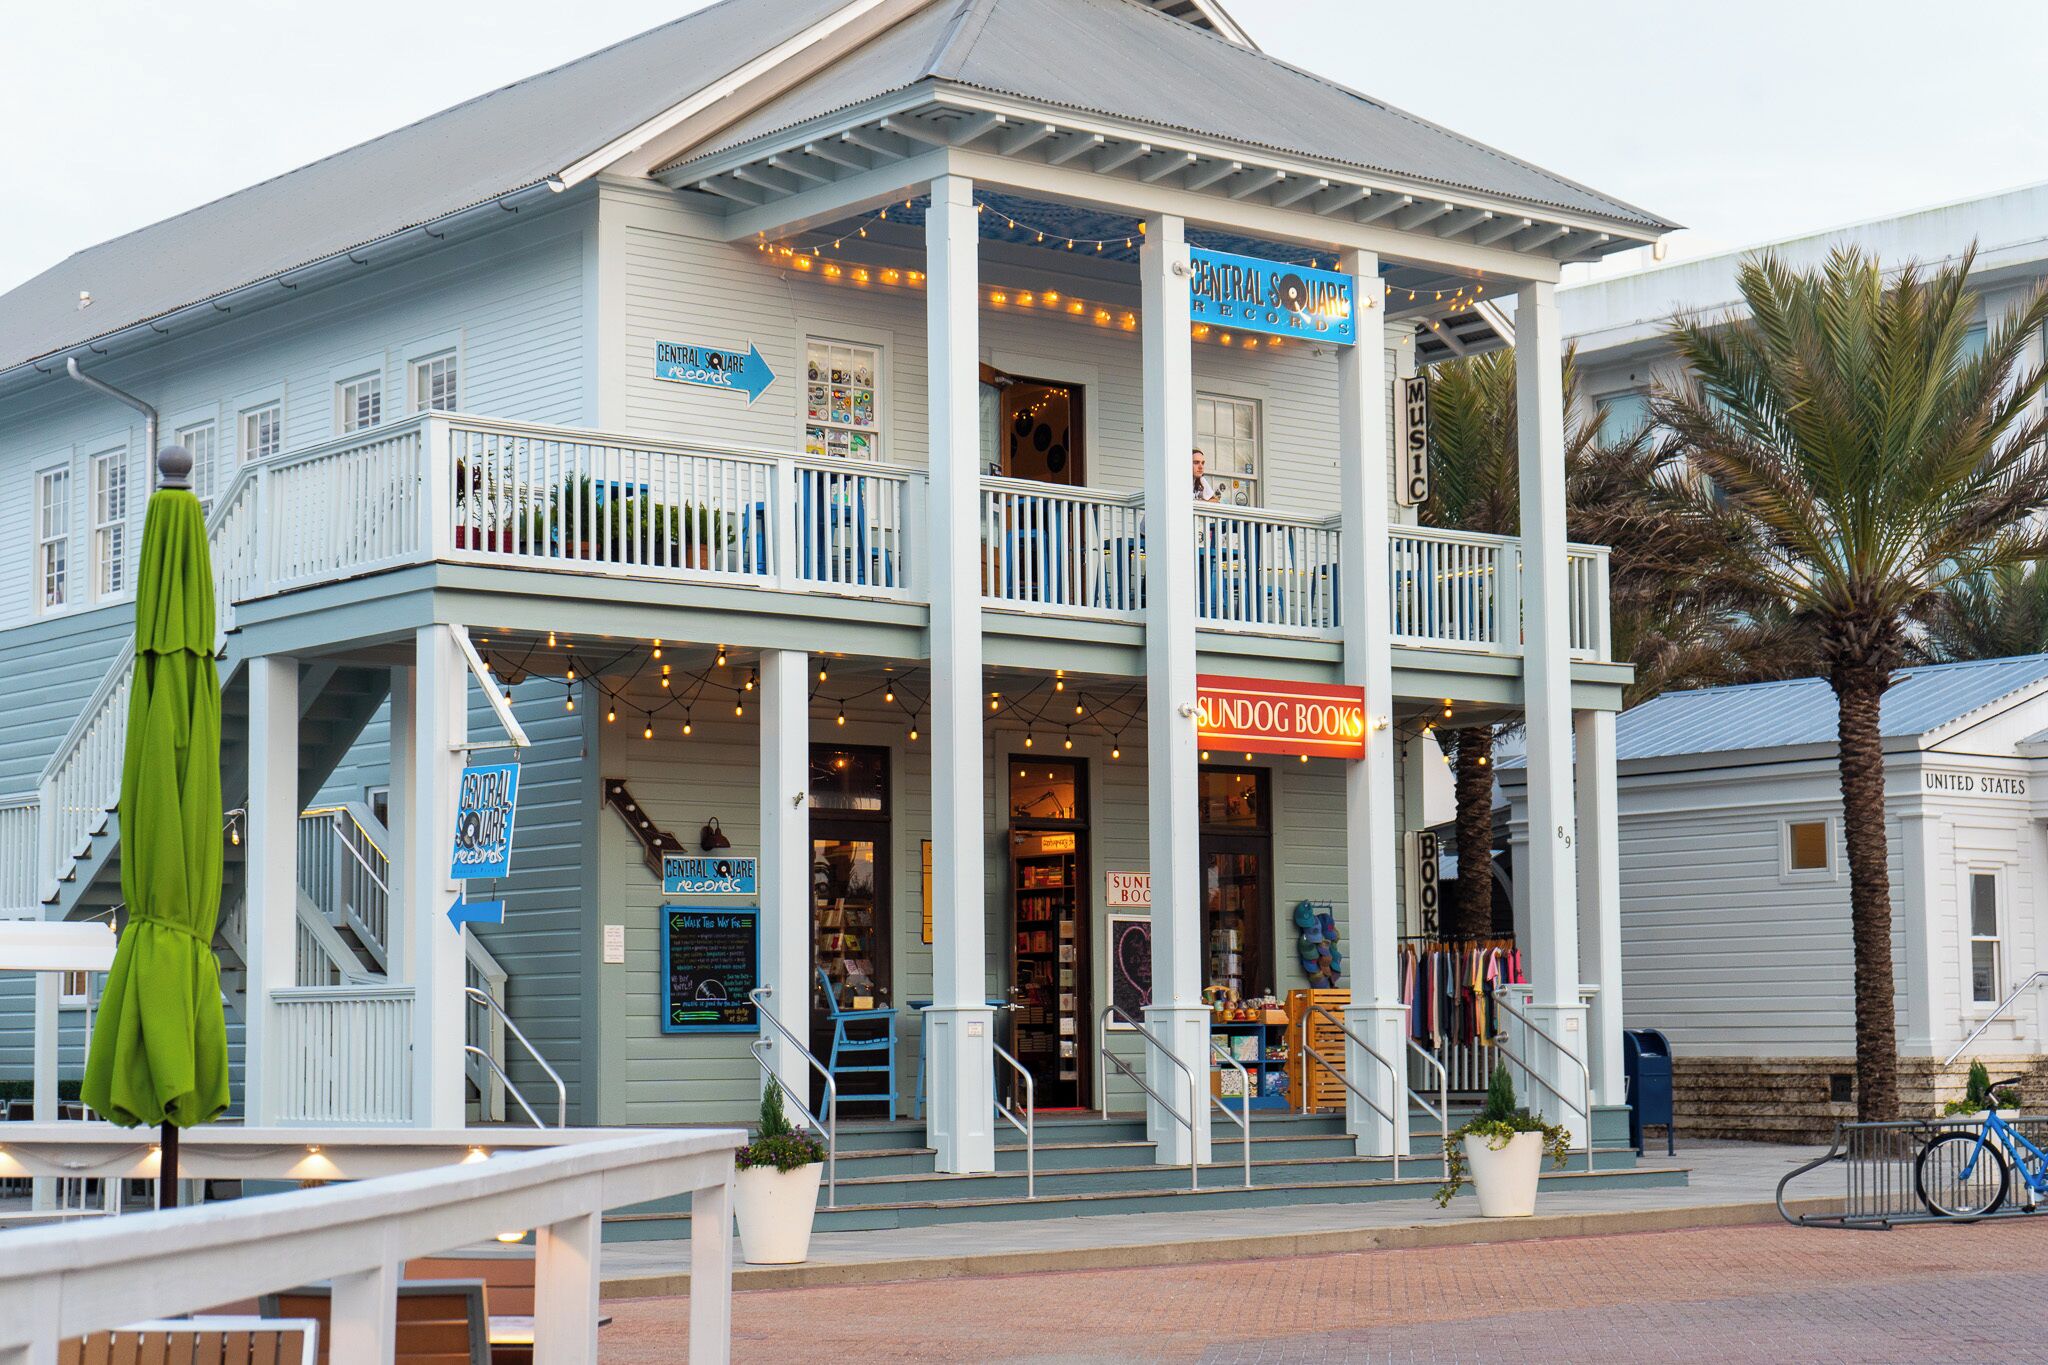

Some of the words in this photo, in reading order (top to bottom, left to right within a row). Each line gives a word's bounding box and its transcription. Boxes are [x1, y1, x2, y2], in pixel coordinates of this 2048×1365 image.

[1190, 257, 1266, 307] CENTRAL
[1268, 272, 1350, 319] SQUARE
[1193, 299, 1351, 335] RECORDS
[657, 343, 700, 368] CENTRAL
[704, 351, 744, 374] SQUARE
[668, 364, 732, 386] records
[1408, 381, 1426, 500] MUSIC
[1197, 696, 1289, 733] SUNDOG
[1295, 703, 1363, 738] BOOKS
[461, 769, 513, 812] CENTRAL
[1925, 773, 1974, 791] UNITED
[1981, 777, 2025, 795] STATES
[455, 807, 508, 849] SQUARE
[1557, 825, 1571, 849] 89
[453, 845, 506, 865] records
[666, 858, 708, 878] CENTRAL
[712, 859, 753, 879] SQUARE
[676, 877, 741, 893] records
[1421, 835, 1439, 940] BOOK
